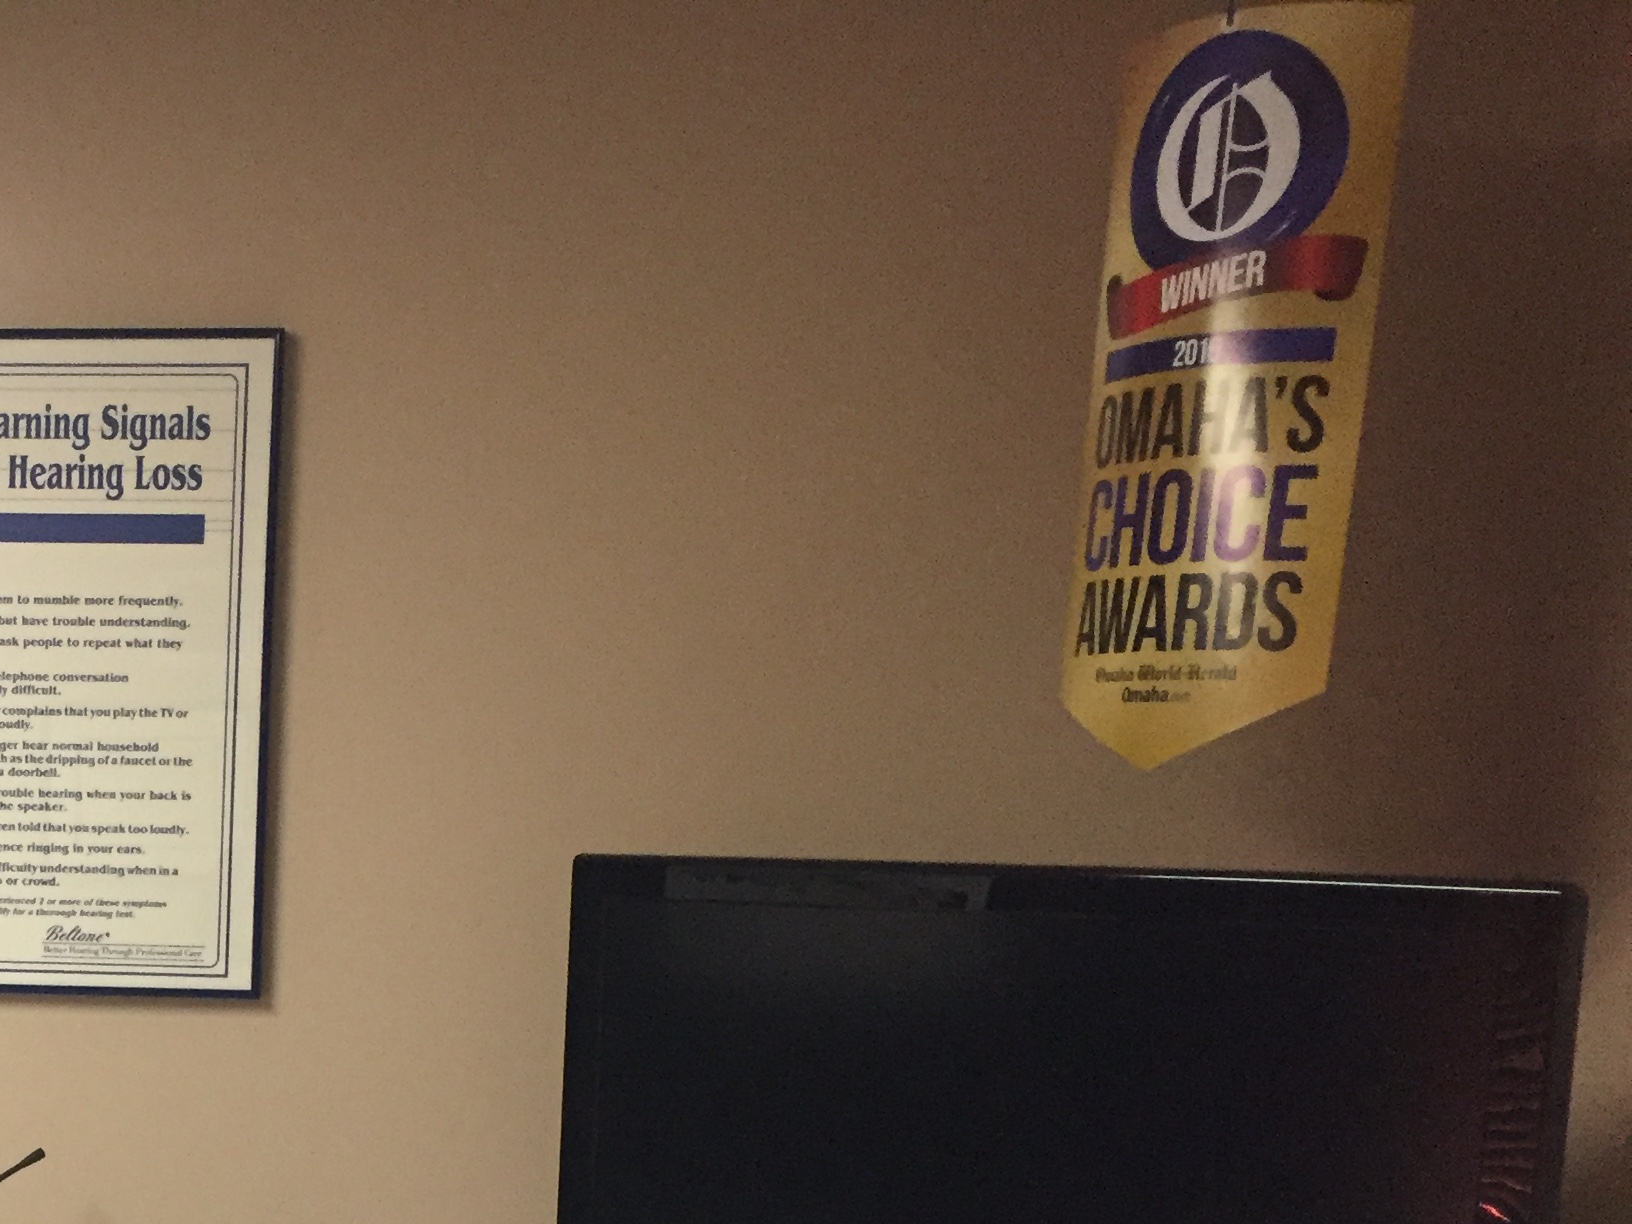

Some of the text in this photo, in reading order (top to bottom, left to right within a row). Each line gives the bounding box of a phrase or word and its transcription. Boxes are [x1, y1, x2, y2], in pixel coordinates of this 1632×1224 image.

[1160, 250, 1266, 314] WINNER
[100, 404, 212, 452] Signals
[1096, 374, 1330, 470] OMAHA'S
[8, 455, 124, 500] Hearing
[134, 456, 204, 492] Loss
[1085, 464, 1318, 572] CHOICE
[17, 595, 30, 604] to
[33, 595, 80, 606] mumble
[85, 597, 114, 606] more
[119, 595, 184, 610] frequently.
[1074, 571, 1304, 658] AWARDS
[22, 616, 48, 626] have
[52, 616, 96, 626] trouble
[100, 617, 190, 630] understanding.
[0, 637, 20, 646] ask
[23, 637, 64, 650] people
[67, 637, 80, 648] to
[83, 639, 122, 650] repeat
[125, 638, 152, 648] what
[157, 639, 182, 652] they
[53, 672, 128, 682] conversation
[11, 684, 62, 696] difficult.
[2, 706, 62, 718] complains
[65, 706, 88, 716] that
[90, 708, 110, 718] you
[113, 707, 136, 720] play
[139, 707, 158, 718] the
[160, 708, 174, 718] TV
[176, 710, 188, 718] or
[22, 740, 48, 750] hear
[52, 741, 94, 752] normal
[97, 741, 160, 752] household
[10, 756, 22, 764] as
[24, 754, 44, 764] the
[45, 754, 96, 768] dripping
[97, 755, 110, 766] of
[111, 757, 118, 766] a
[120, 755, 156, 766] faucet
[159, 758, 170, 766] or
[173, 757, 192, 766] the
[8, 767, 62, 778] doorbell.
[38, 788, 82, 802] hearing
[87, 790, 116, 800] when
[120, 791, 146, 802] your
[150, 790, 178, 800] back
[181, 790, 192, 800] is
[17, 802, 68, 814] speaker.
[18, 822, 40, 832] told
[43, 822, 66, 832] that
[68, 825, 90, 834] you
[91, 824, 126, 836] speak
[128, 824, 148, 834] too
[150, 825, 190, 838] loudly.
[27, 842, 70, 856] ringing
[73, 843, 84, 854] in
[87, 845, 114, 856] your
[117, 846, 146, 854] ears.
[40, 863, 124, 878] understanding
[127, 866, 156, 876] when
[159, 865, 170, 876] in
[171, 868, 178, 876] a
[6, 877, 20, 886] or
[22, 876, 60, 886] crowd.
